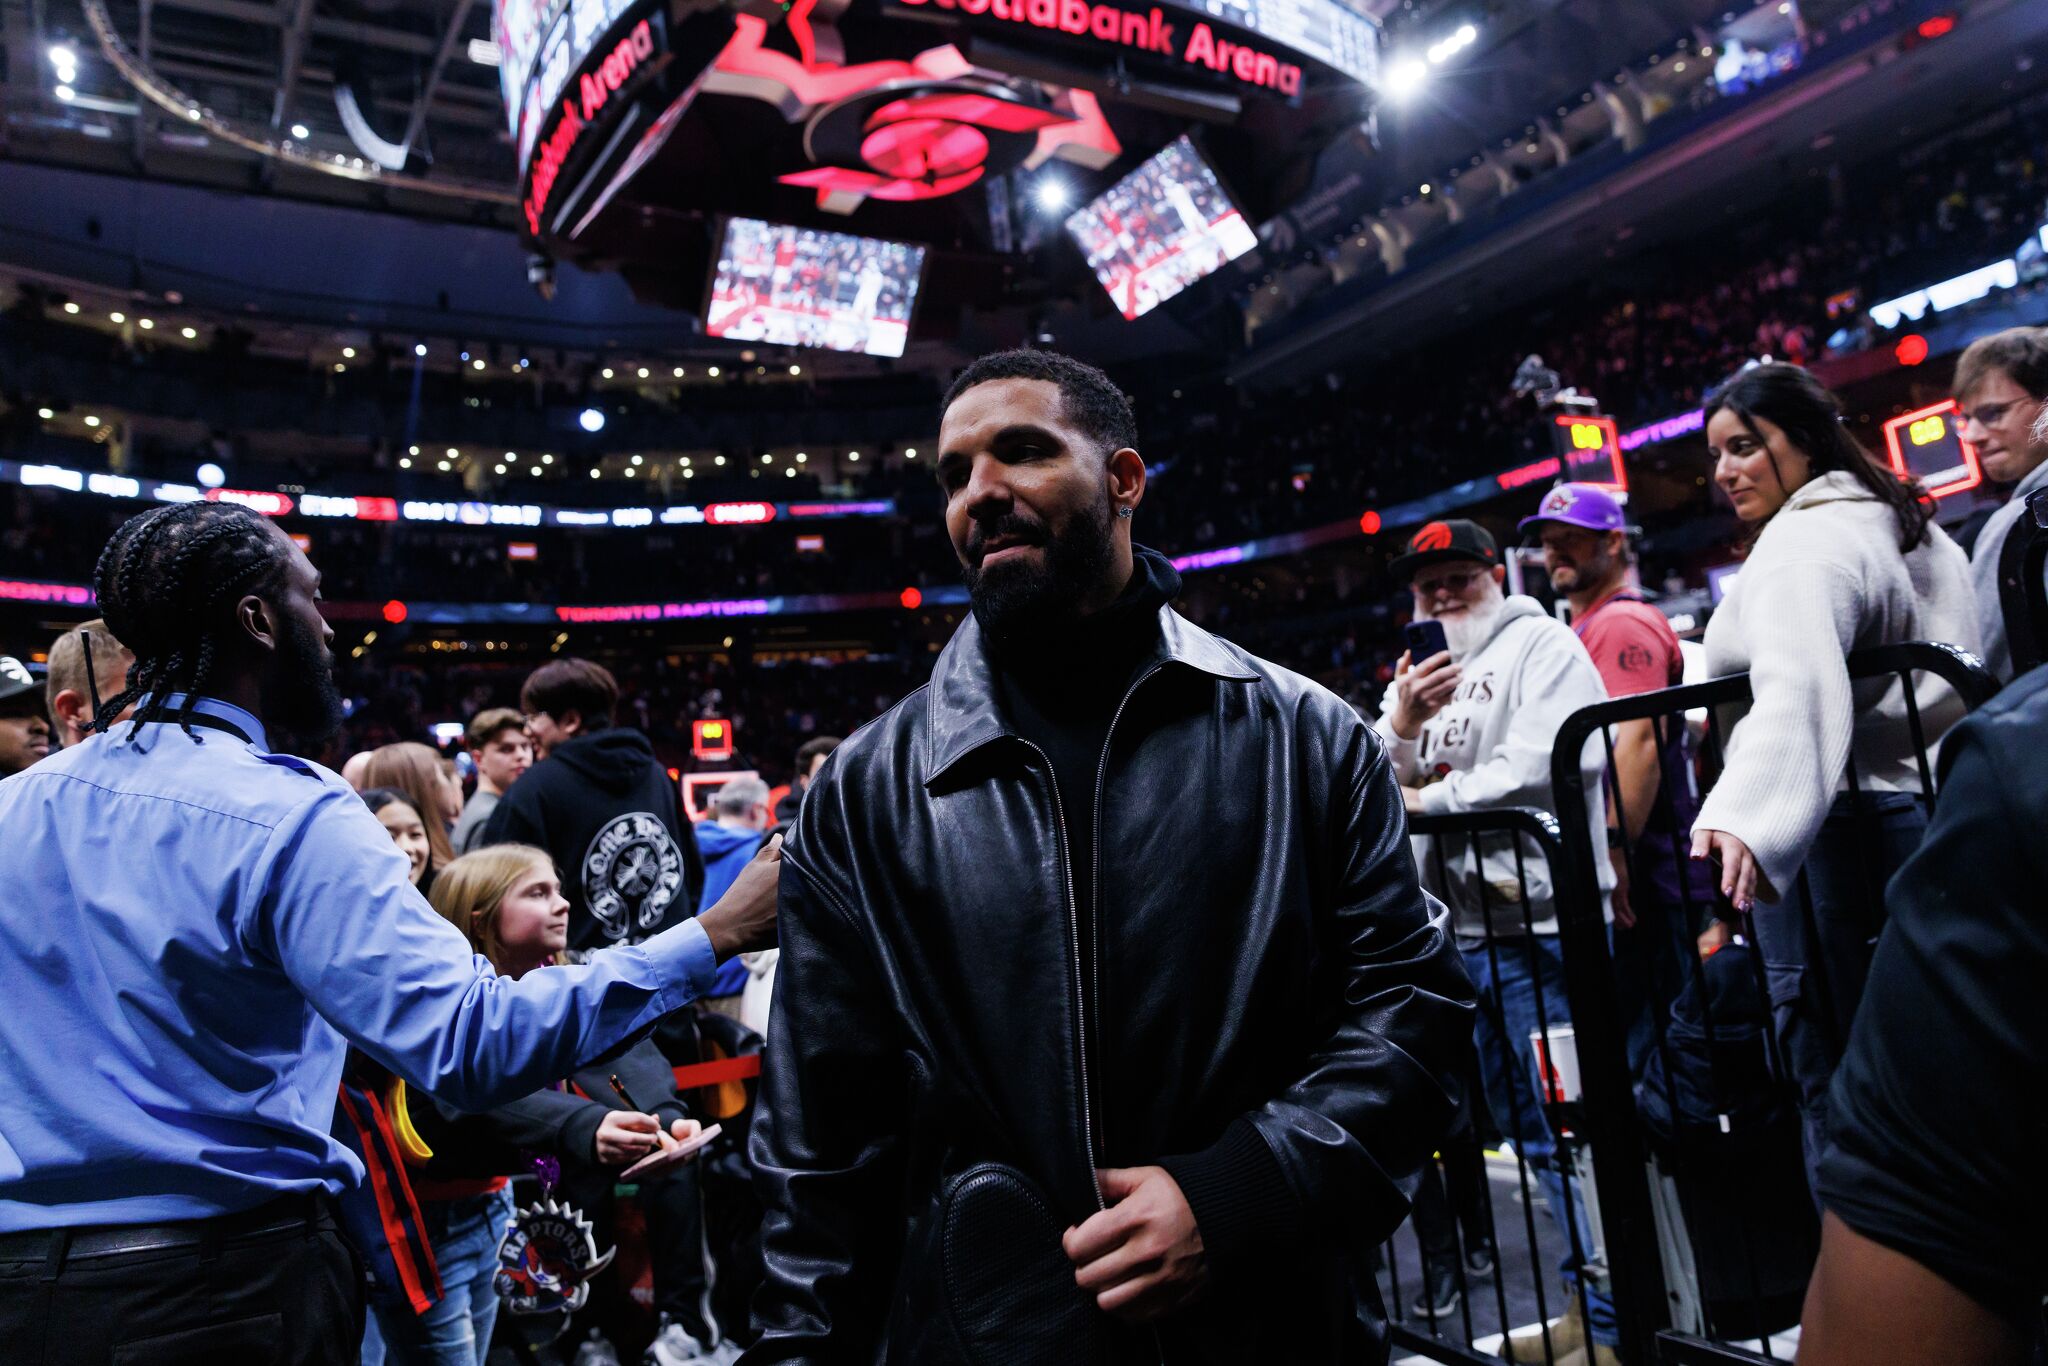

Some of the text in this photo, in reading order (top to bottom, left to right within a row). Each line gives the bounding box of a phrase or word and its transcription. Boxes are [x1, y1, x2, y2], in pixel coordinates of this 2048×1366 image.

[580, 19, 655, 121] Arena
[903, 0, 1302, 97] tiabank Arena
[555, 599, 769, 622] TORONTO RAPTORS
[502, 1220, 588, 1261] RAPTORS
